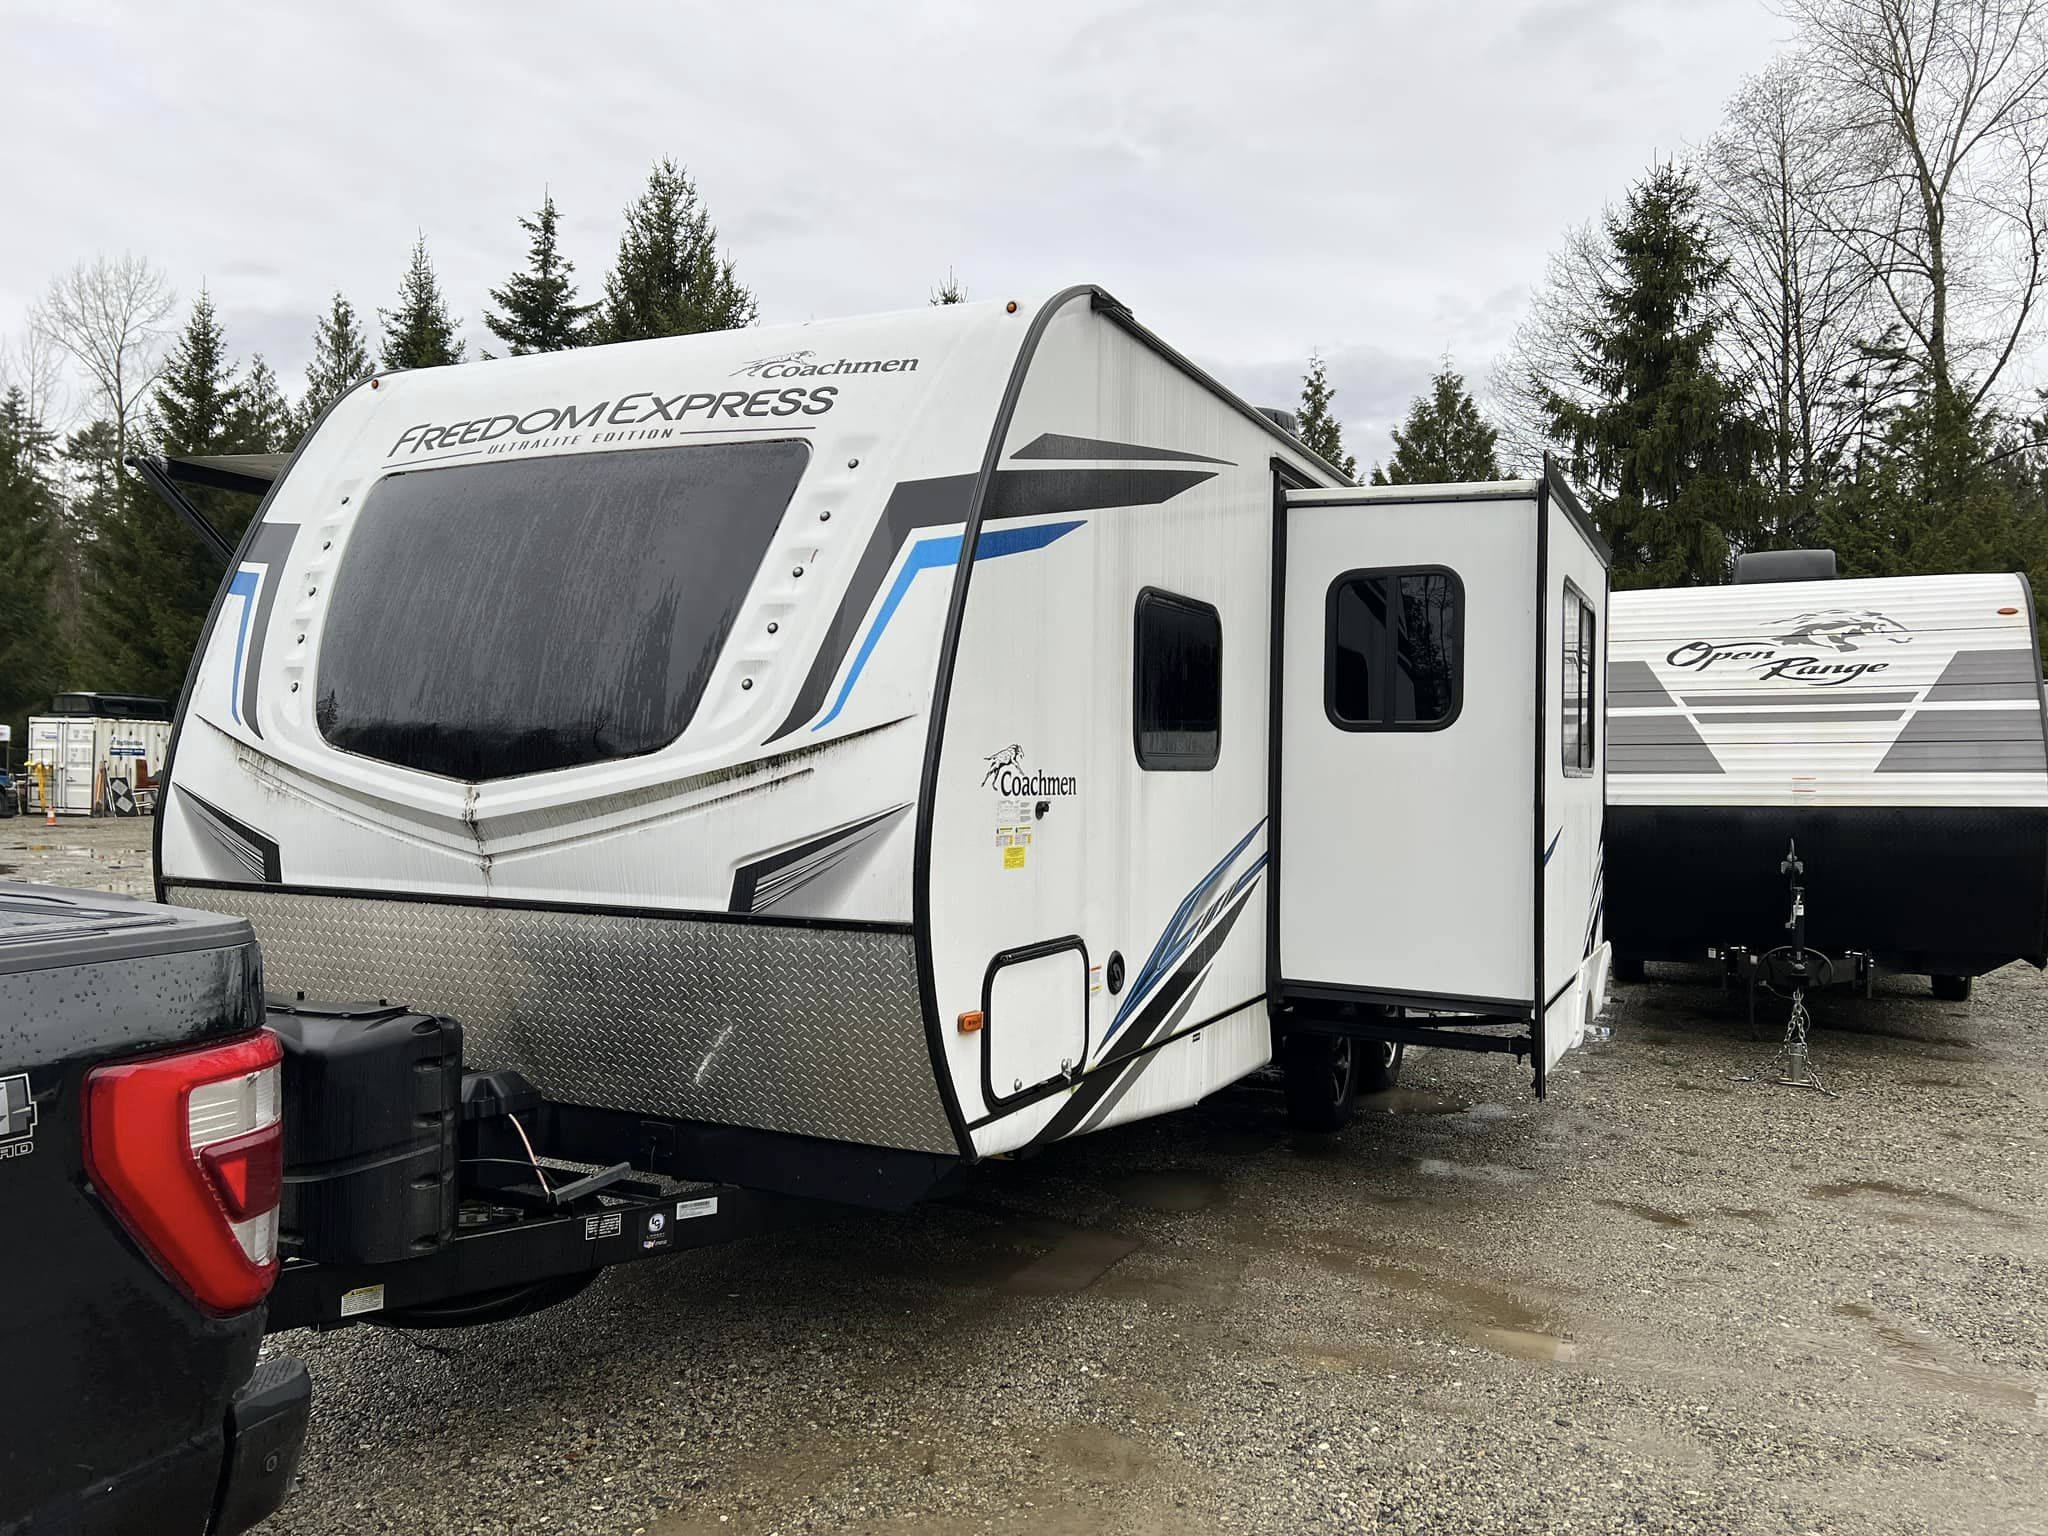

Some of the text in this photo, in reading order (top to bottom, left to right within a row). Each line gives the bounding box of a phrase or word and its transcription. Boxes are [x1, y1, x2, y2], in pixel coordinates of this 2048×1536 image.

[761, 358, 920, 379] Coachmen
[386, 386, 839, 458] FREEDOM EXPRESS
[487, 427, 674, 455] ULTRALITE EDITION
[1666, 641, 1779, 672] Open
[1746, 656, 1889, 686] Range
[1000, 768, 1077, 797] Coachmen
